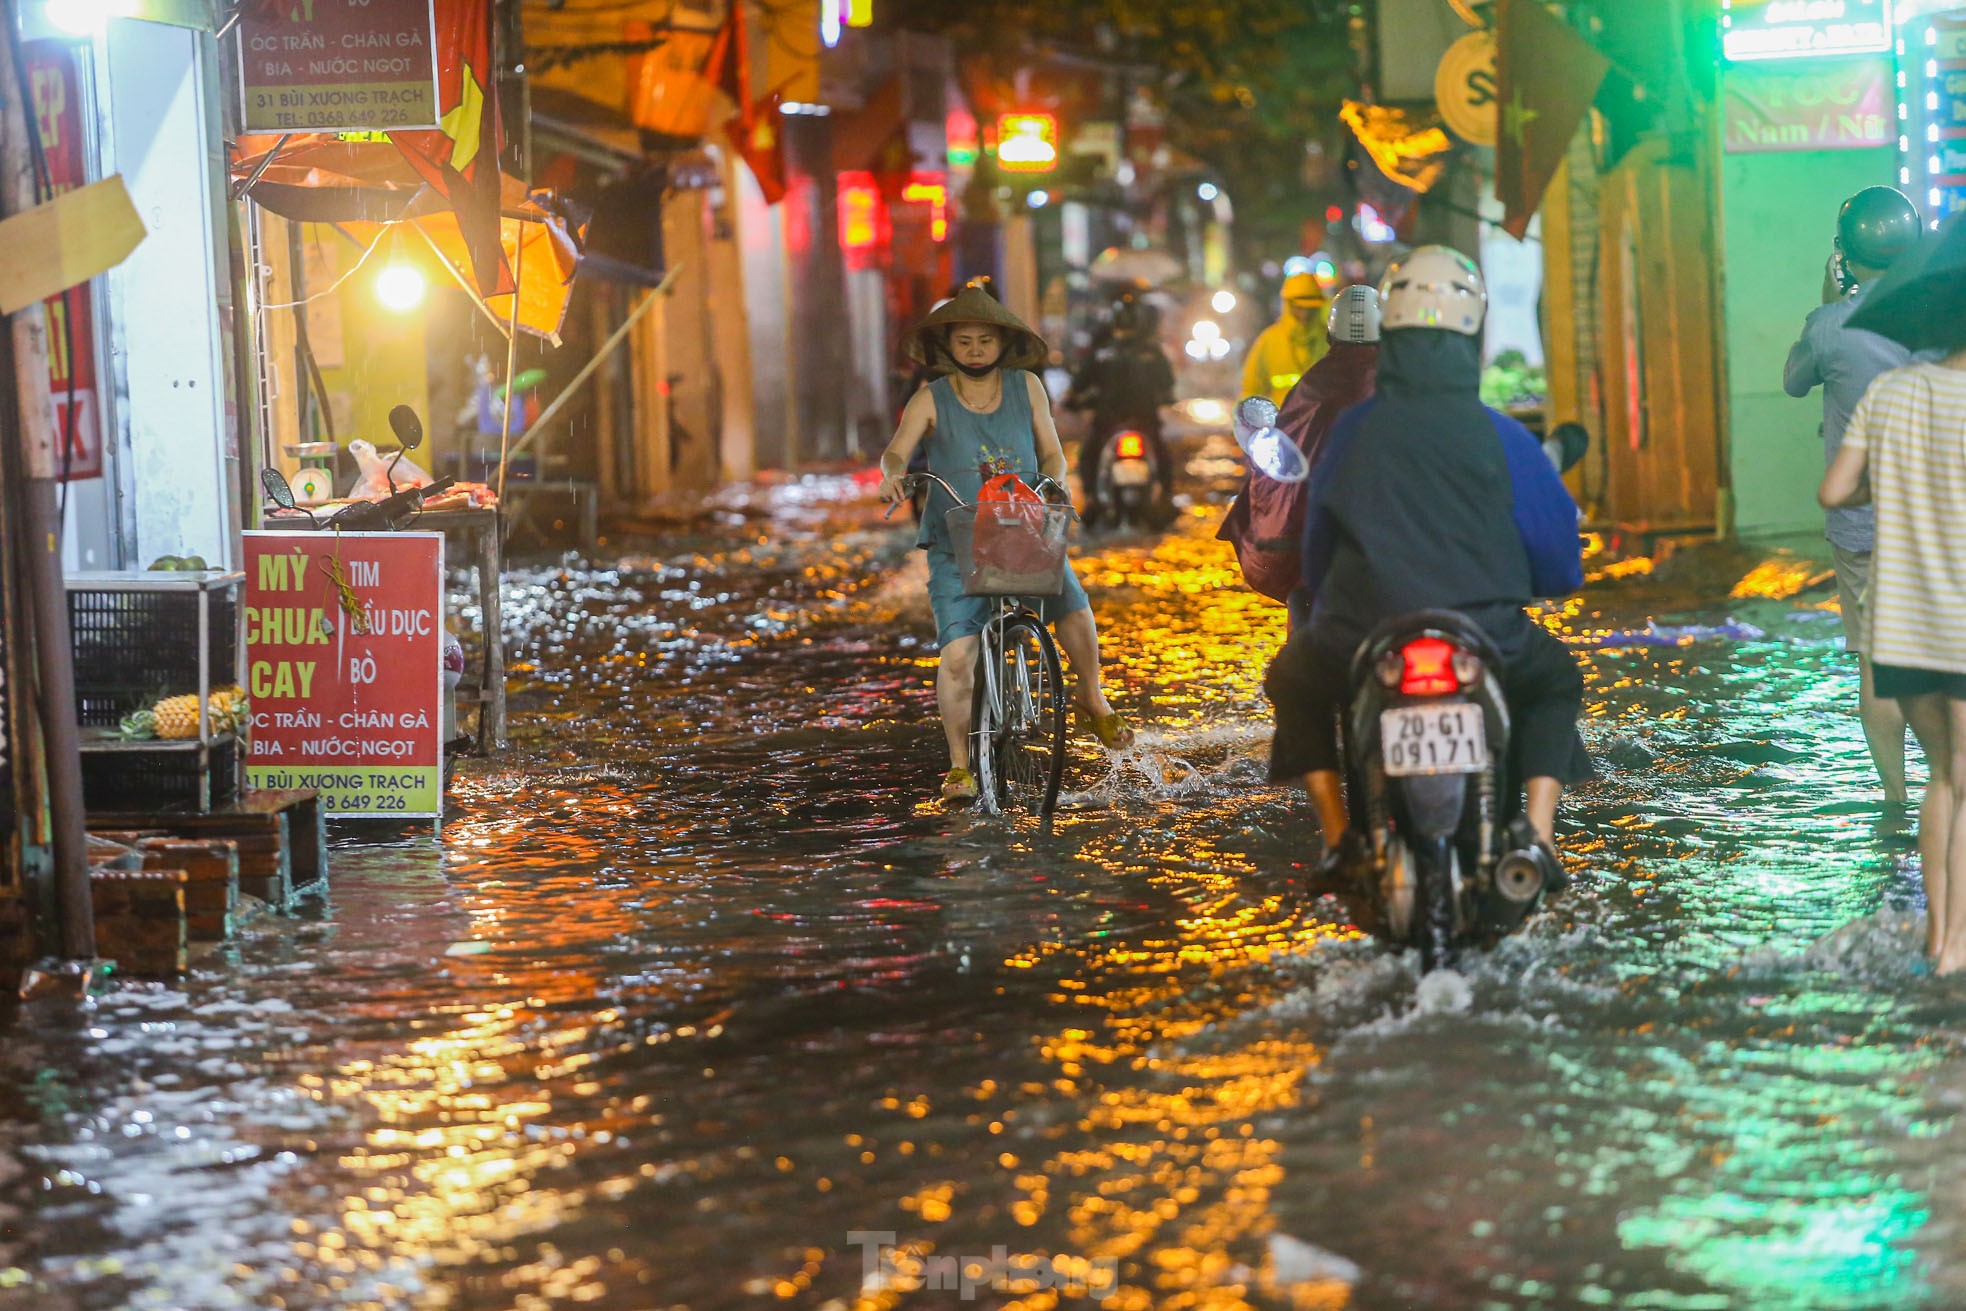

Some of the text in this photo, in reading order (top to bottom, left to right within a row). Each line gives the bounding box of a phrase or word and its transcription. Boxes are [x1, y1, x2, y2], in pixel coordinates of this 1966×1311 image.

[341, 31, 392, 49] CHÂN
[396, 28, 423, 47] GÀ
[265, 62, 293, 77] BIA
[308, 56, 359, 75] NƯỚC
[363, 58, 412, 77] NGỌT
[256, 89, 424, 109] 31 BÙI XƯƠNG TRẠCH
[275, 109, 409, 127] TEL: 0368 649 226
[1734, 117, 1810, 145] Nam
[258, 546, 310, 592] MỲ
[349, 560, 380, 587] TIM
[244, 607, 330, 645] CHUA
[391, 609, 431, 642] DỤC
[350, 649, 377, 684] BÒ
[251, 660, 317, 699] CAY
[274, 707, 321, 729] TRẦN
[339, 709, 394, 729] CHÂN
[399, 708, 430, 729] GÀ
[253, 740, 283, 755] BIA
[301, 736, 356, 756] NƯỚC
[361, 740, 415, 759] NGỌT
[1391, 738, 1477, 767] 09171
[266, 770, 293, 789] BÙI
[298, 773, 363, 790] XƯƠNG
[368, 774, 426, 792] TRẠCH
[341, 795, 371, 810] 649
[376, 795, 406, 810] 226
